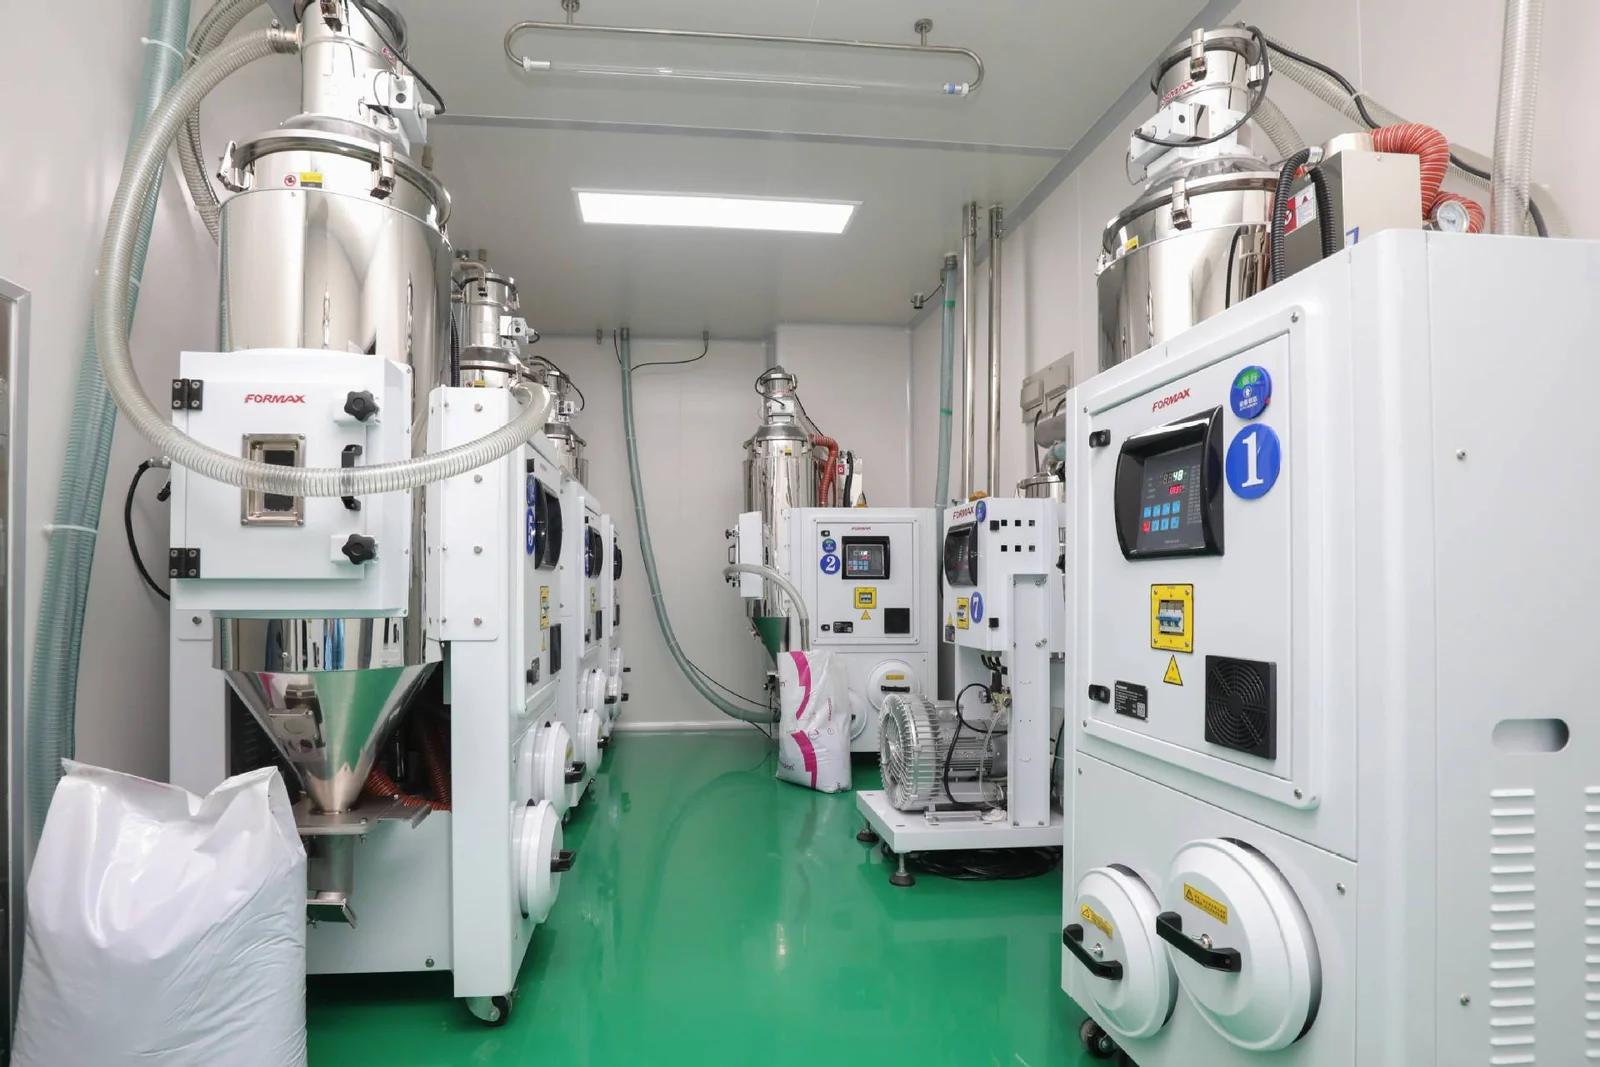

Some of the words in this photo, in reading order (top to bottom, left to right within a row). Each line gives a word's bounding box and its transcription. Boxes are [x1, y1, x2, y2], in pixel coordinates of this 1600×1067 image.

[244, 394, 306, 404] FORMAX
[1152, 387, 1191, 413] FORMAX
[1241, 431, 1264, 488] 1
[952, 506, 974, 520] FORMAX
[825, 556, 836, 572] 2
[973, 597, 980, 619] 7
